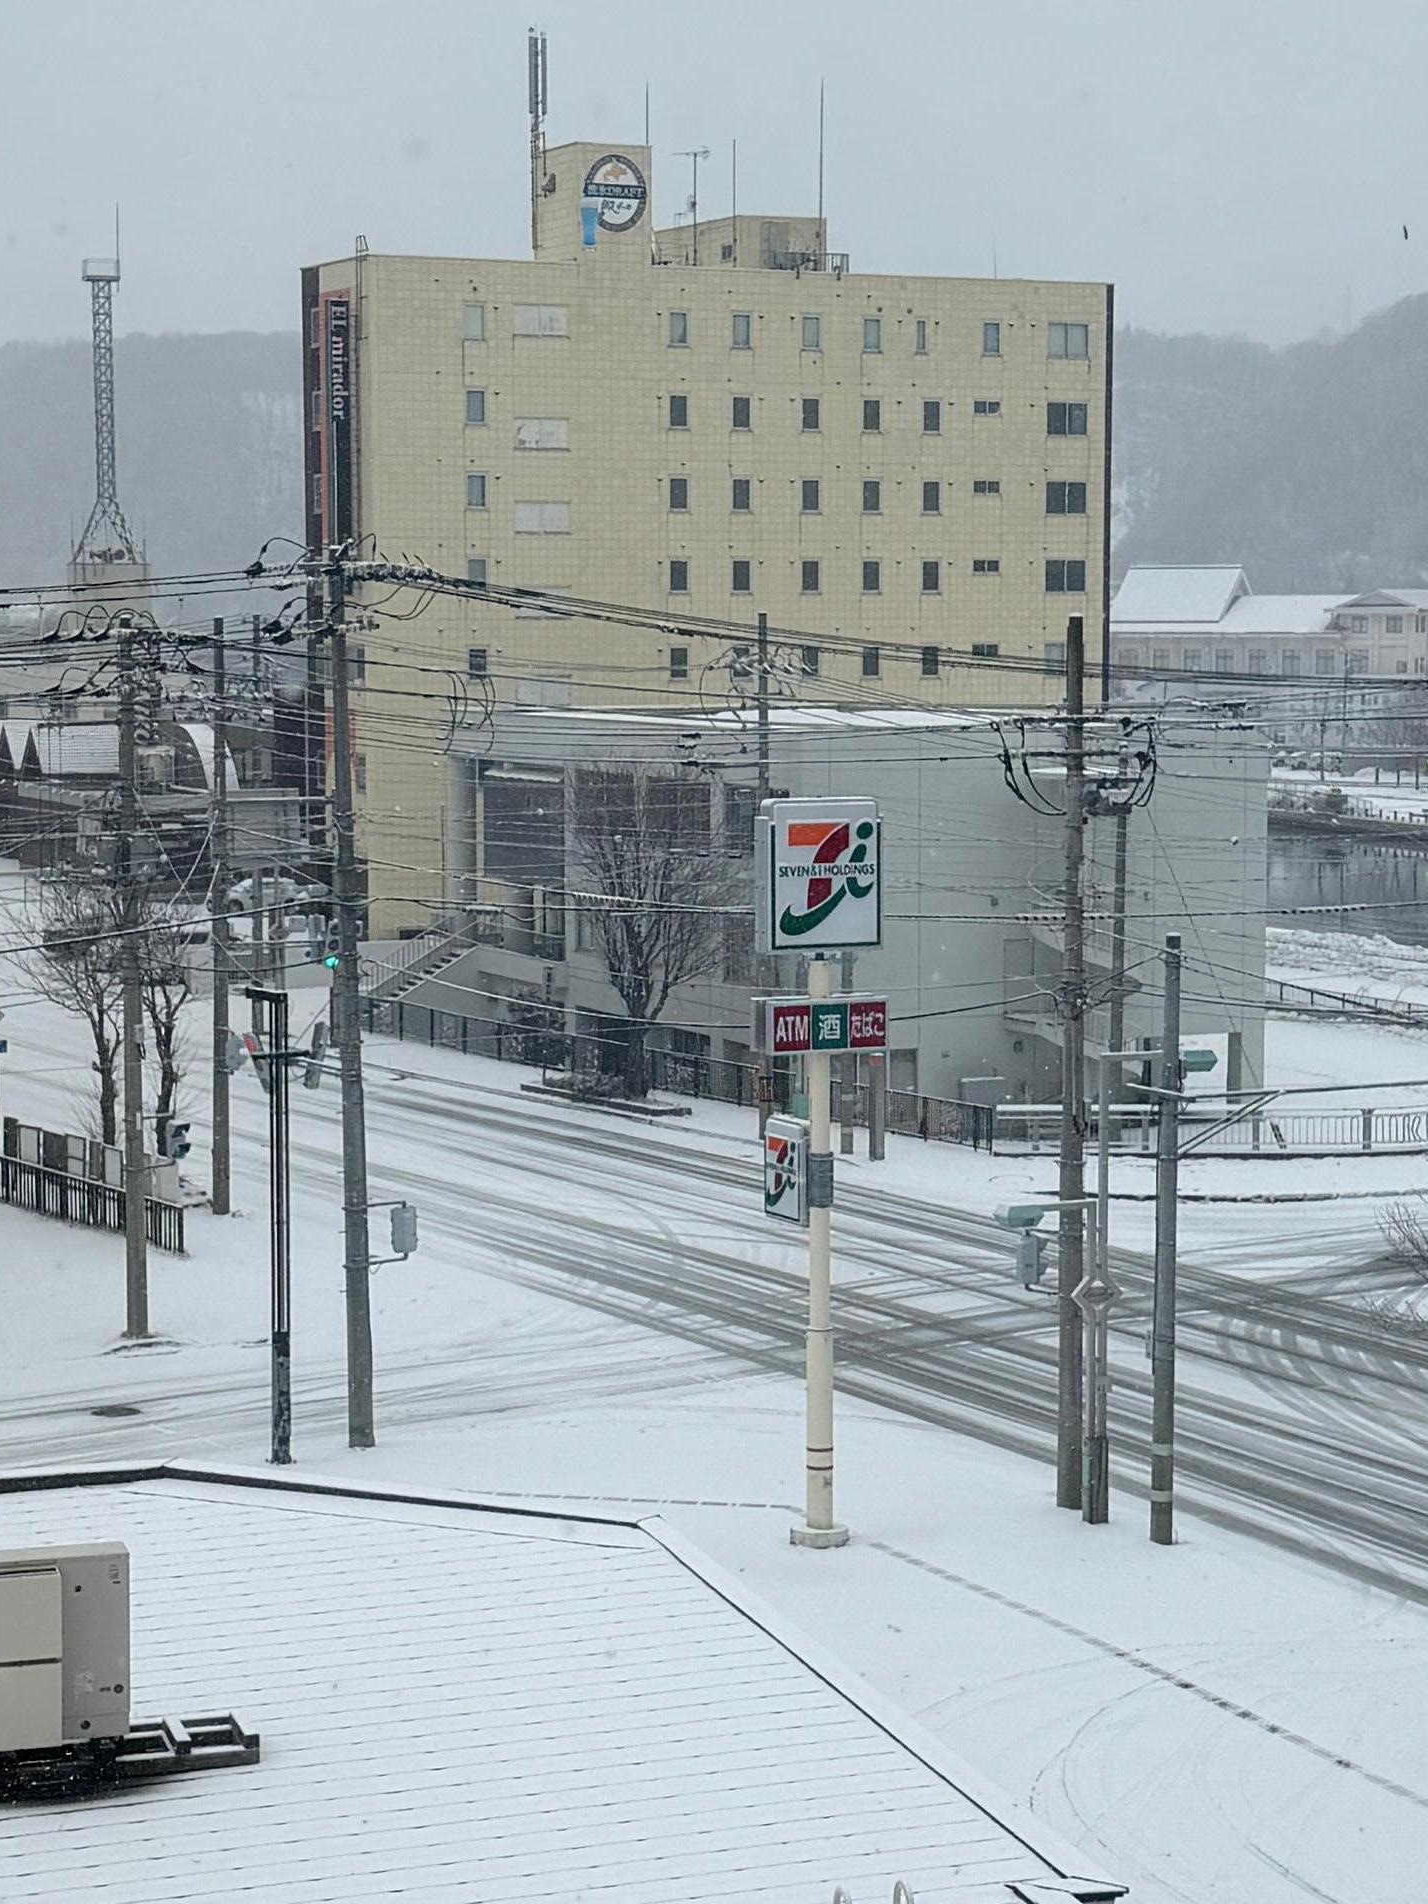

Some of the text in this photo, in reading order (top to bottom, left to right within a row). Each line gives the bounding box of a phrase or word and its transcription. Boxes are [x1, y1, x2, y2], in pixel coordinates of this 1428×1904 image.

[331, 306, 349, 420] EL mirador
[823, 863, 875, 876] HOLDINGS
[776, 1010, 885, 1043] ATM 酒 たばこ
